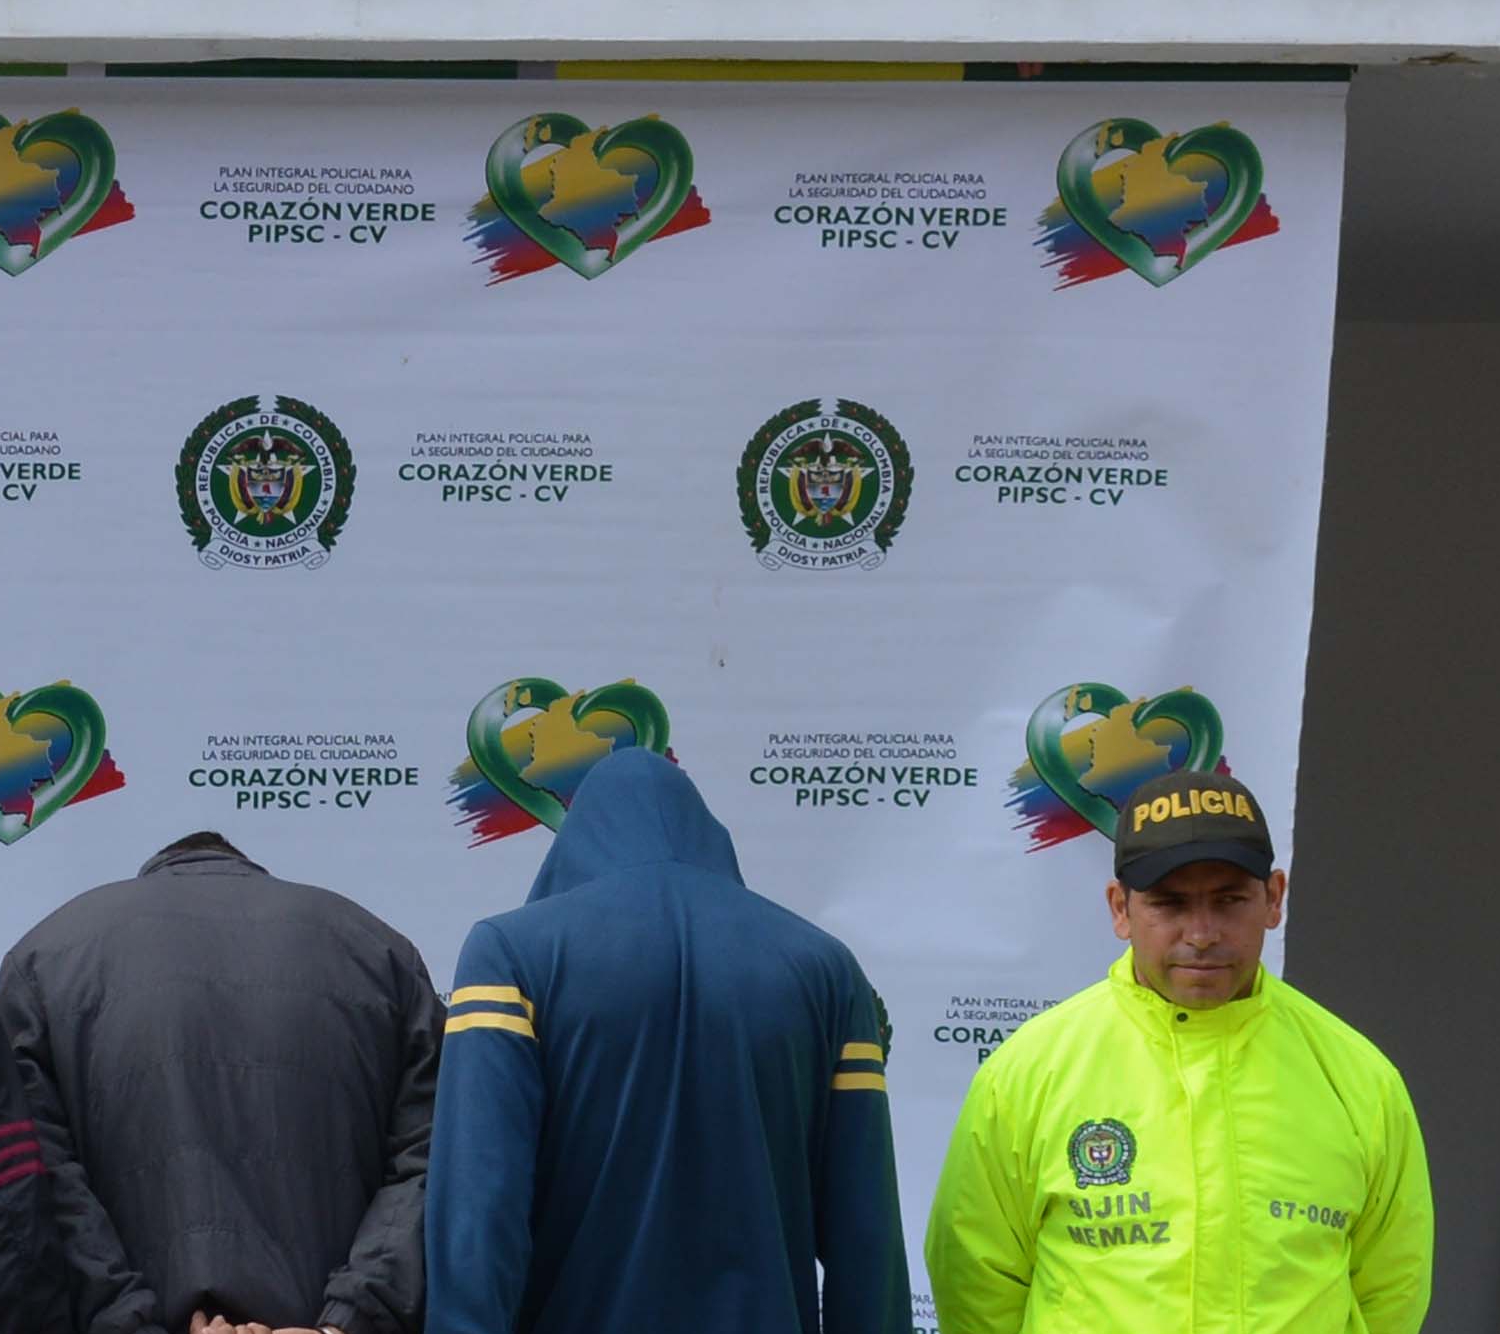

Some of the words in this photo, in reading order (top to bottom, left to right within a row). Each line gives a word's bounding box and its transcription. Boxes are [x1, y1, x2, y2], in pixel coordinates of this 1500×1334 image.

[199, 196, 342, 222] CORAZÓN
[346, 202, 437, 222] VERDE
[773, 201, 915, 227] CORAZÓN
[919, 206, 1008, 227] VERDE
[248, 223, 325, 244] PIPSC
[348, 224, 388, 244] CV
[821, 228, 898, 250] PIPSC
[921, 229, 960, 250] CV
[973, 434, 1003, 446] PLAN
[1005, 435, 1062, 448] INTEGRAL
[1064, 437, 1115, 448] POLICIAL
[1118, 438, 1148, 448] PARA
[967, 448, 982, 459] LA
[984, 448, 1050, 460] SEGURIDAD
[1052, 450, 1074, 460] DEL
[1076, 450, 1150, 462] CIUDADANO
[0, 462, 81, 481] VERDE
[398, 458, 528, 482] CORAZÓN
[531, 463, 613, 483] VERDE
[954, 462, 1083, 484] CORAZÓN
[1087, 466, 1169, 486] VERDE
[2, 483, 38, 502] CV
[442, 484, 513, 503] PIPSC
[533, 484, 569, 503] CV
[997, 485, 1067, 505] PIPSC
[1088, 487, 1125, 505] CV
[188, 762, 328, 788] CORAZÓN
[331, 766, 419, 787] VERDE
[749, 760, 887, 786] CORAZÓN
[890, 765, 979, 788] VERDE
[236, 789, 311, 810] PIPSC
[334, 789, 373, 809] CV
[795, 787, 870, 808] PIPSC
[892, 788, 931, 808] CV
[1133, 788, 1256, 833] POLICIA
[1068, 1191, 1152, 1220] SIJIN
